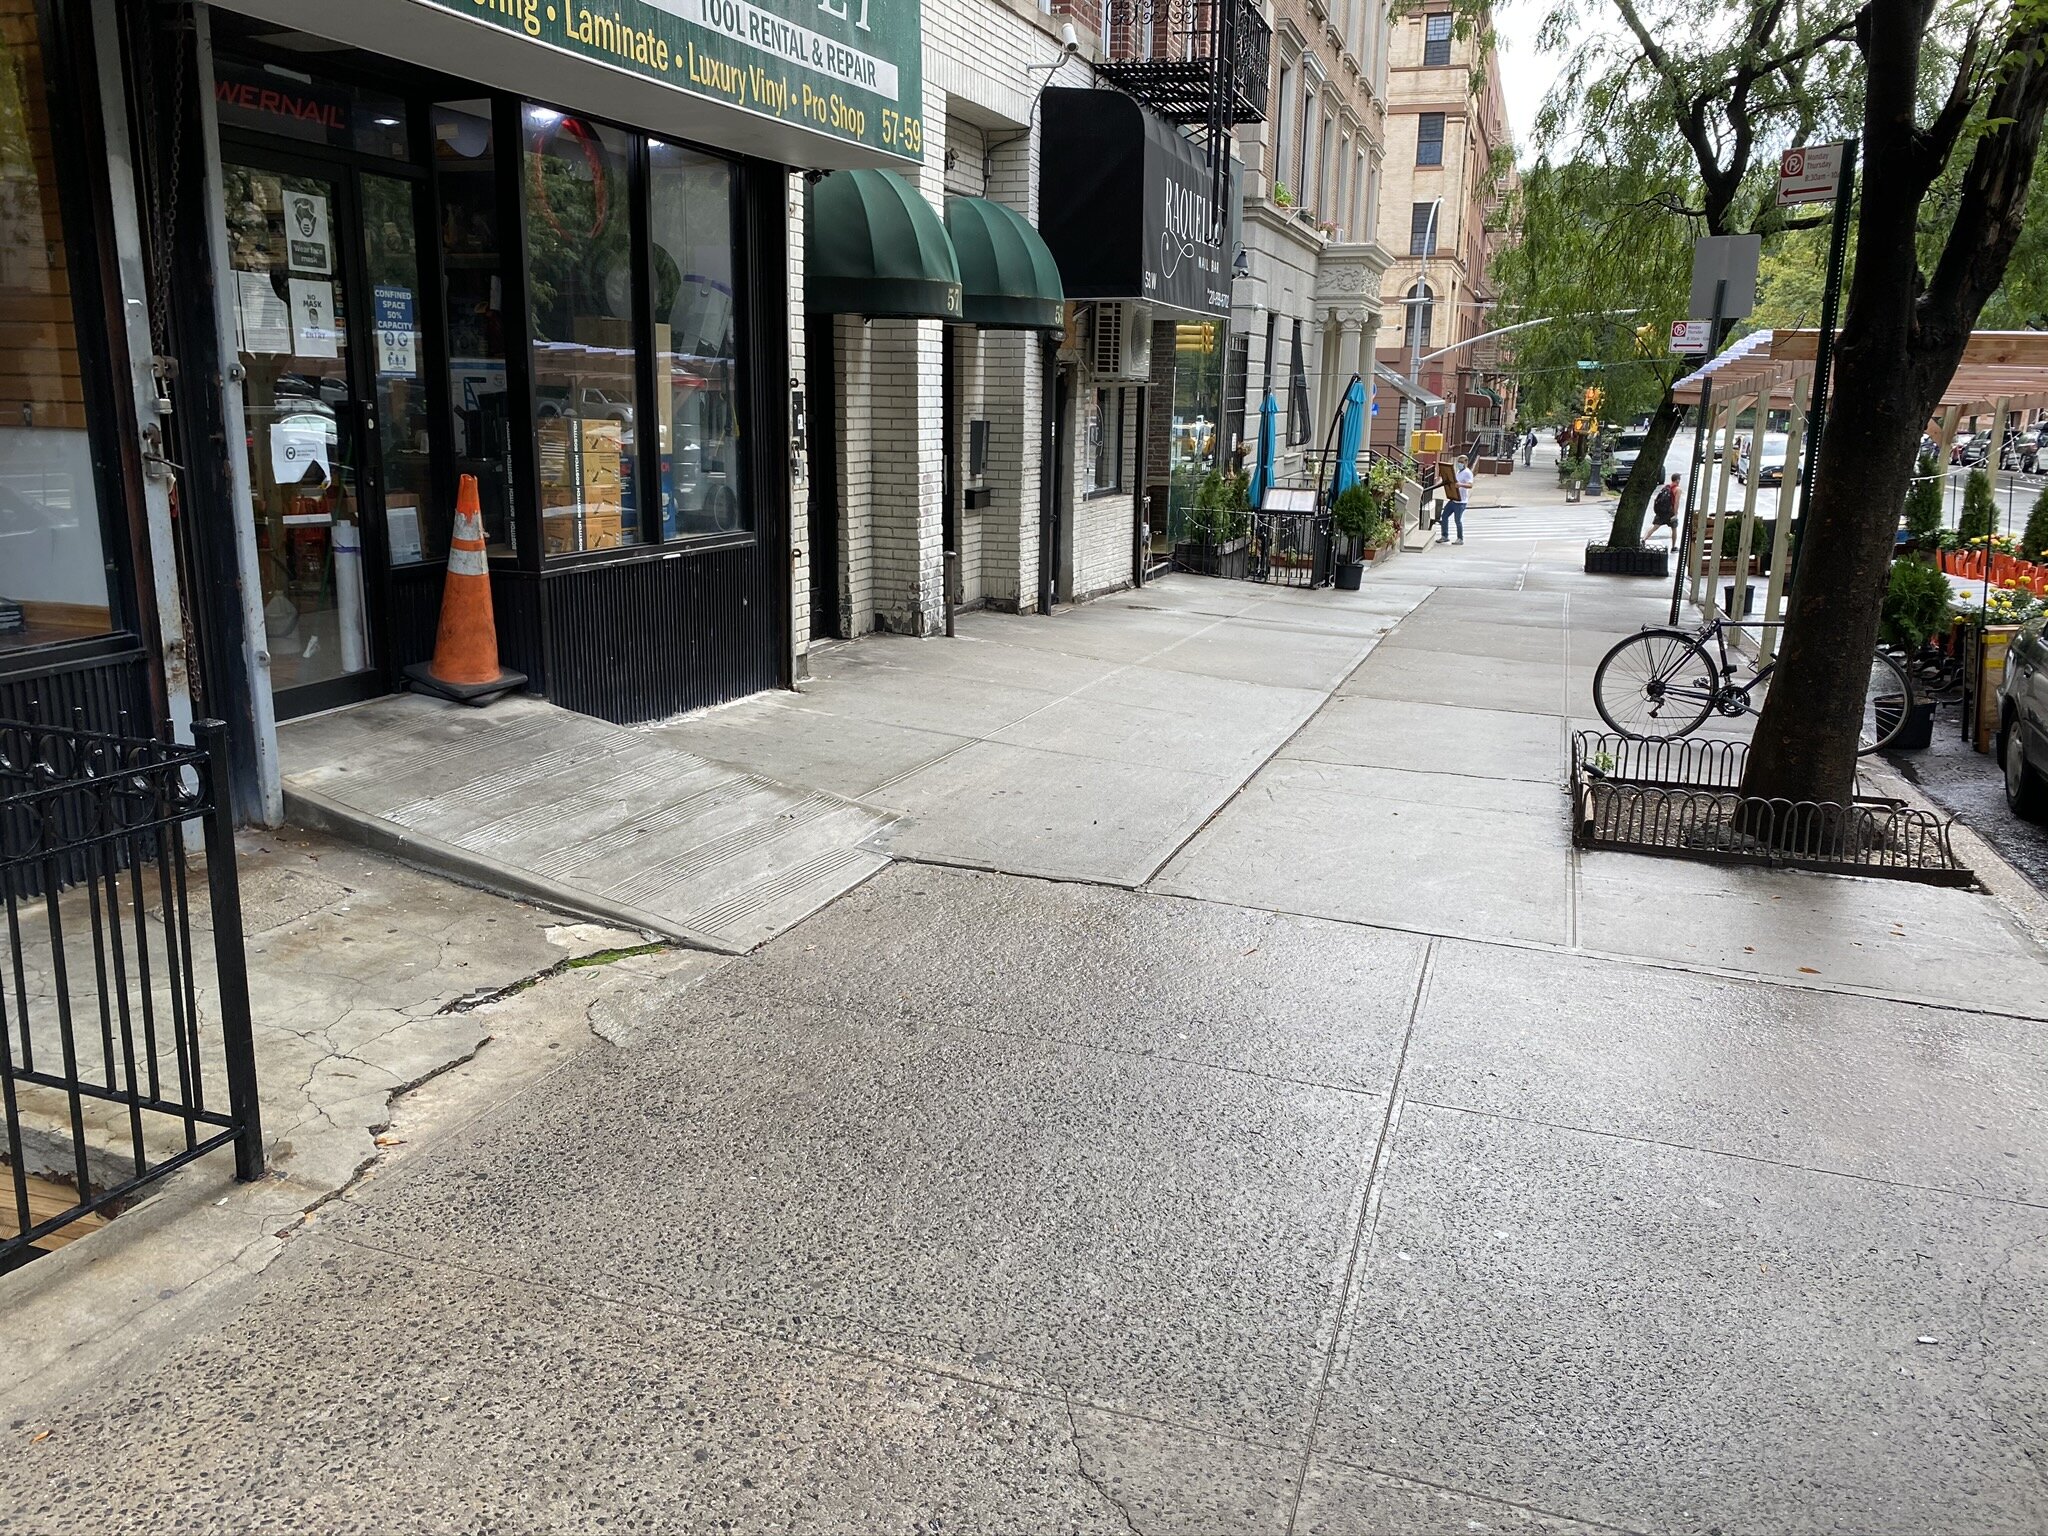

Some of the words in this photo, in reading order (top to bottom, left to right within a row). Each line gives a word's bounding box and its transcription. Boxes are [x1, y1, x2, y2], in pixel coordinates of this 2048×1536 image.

[700, 0, 745, 37] TOOL
[749, 10, 808, 63] RENTAL
[811, 38, 824, 68] &
[827, 43, 877, 88] REPAIR
[565, 0, 669, 71] Laminate
[688, 41, 746, 106] Luxury
[749, 64, 788, 117] Vinyl
[803, 84, 827, 124] Pro
[830, 94, 865, 141] Shop
[882, 108, 922, 153] 57-59
[374, 289, 412, 300] CONFINED
[947, 288, 959, 311] 57
[303, 300, 322, 308] MASK
[382, 300, 406, 310] SPACE
[387, 310, 402, 320] 50%
[378, 320, 413, 330] CAPACITY
